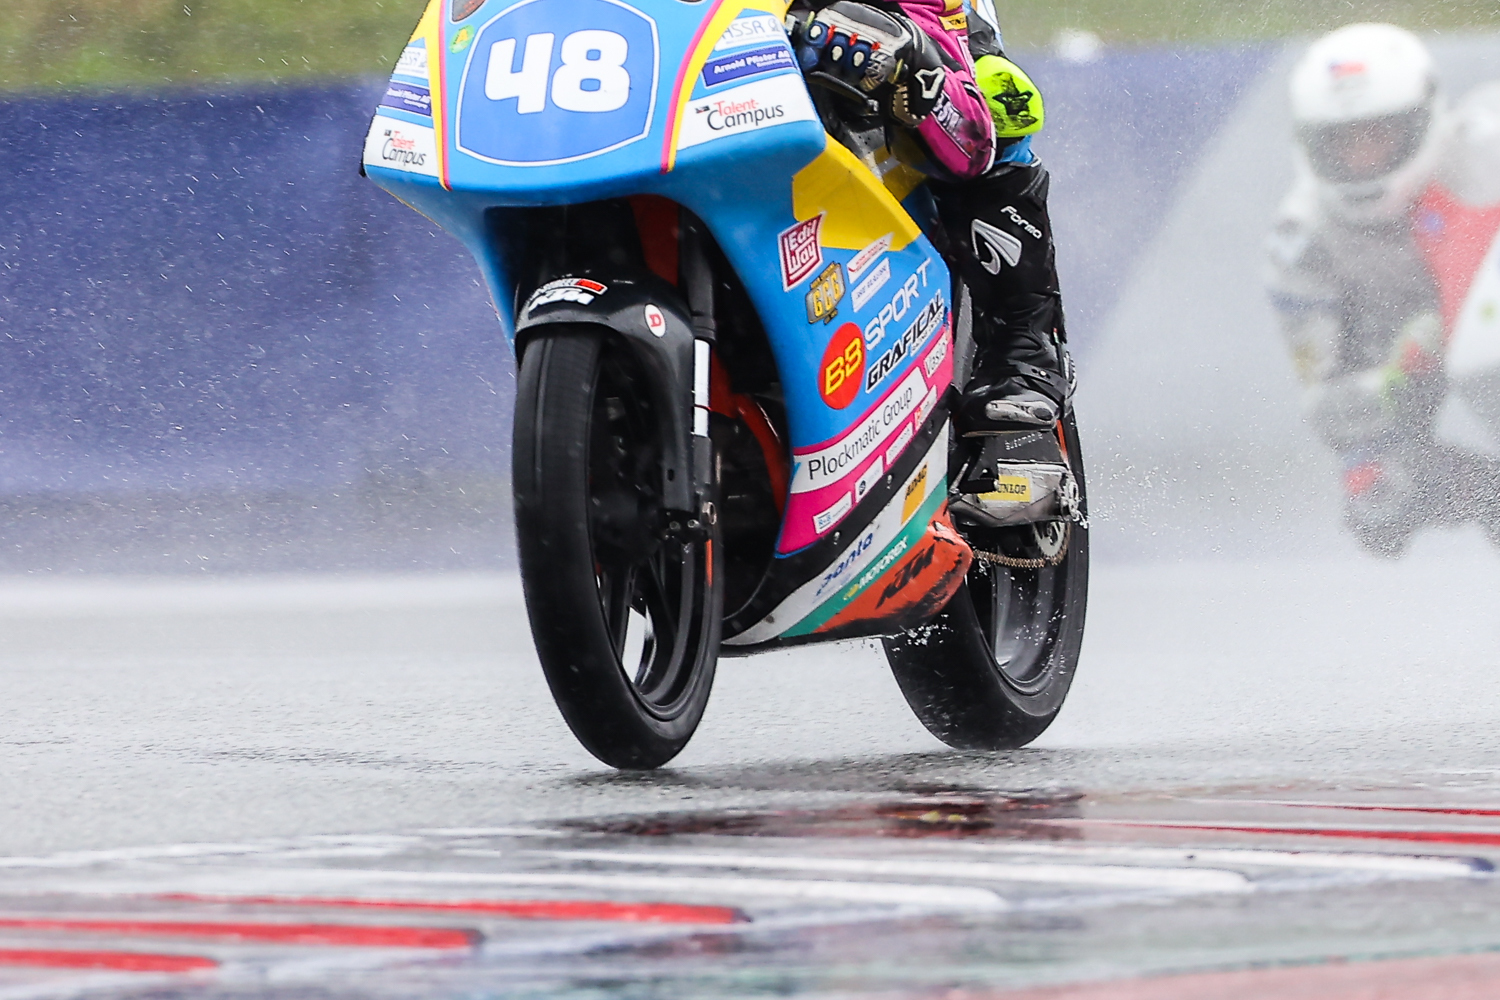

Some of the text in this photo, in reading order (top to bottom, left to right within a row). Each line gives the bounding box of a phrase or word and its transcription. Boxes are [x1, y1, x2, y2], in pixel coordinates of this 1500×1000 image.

[484, 28, 631, 115] 48
[706, 104, 784, 131] Campus
[714, 98, 760, 117] Talent-
[382, 137, 428, 167] Campus
[788, 219, 817, 251] Edil
[1000, 205, 1043, 240] Forma
[863, 257, 933, 351] SPORT
[866, 291, 944, 392] GRAFICAL
[808, 418, 881, 480] Plockmatic
[882, 387, 913, 427] Group
[997, 482, 1027, 496] UNLOP
[858, 535, 909, 590] MOTOREX
[875, 543, 936, 610] KTM
